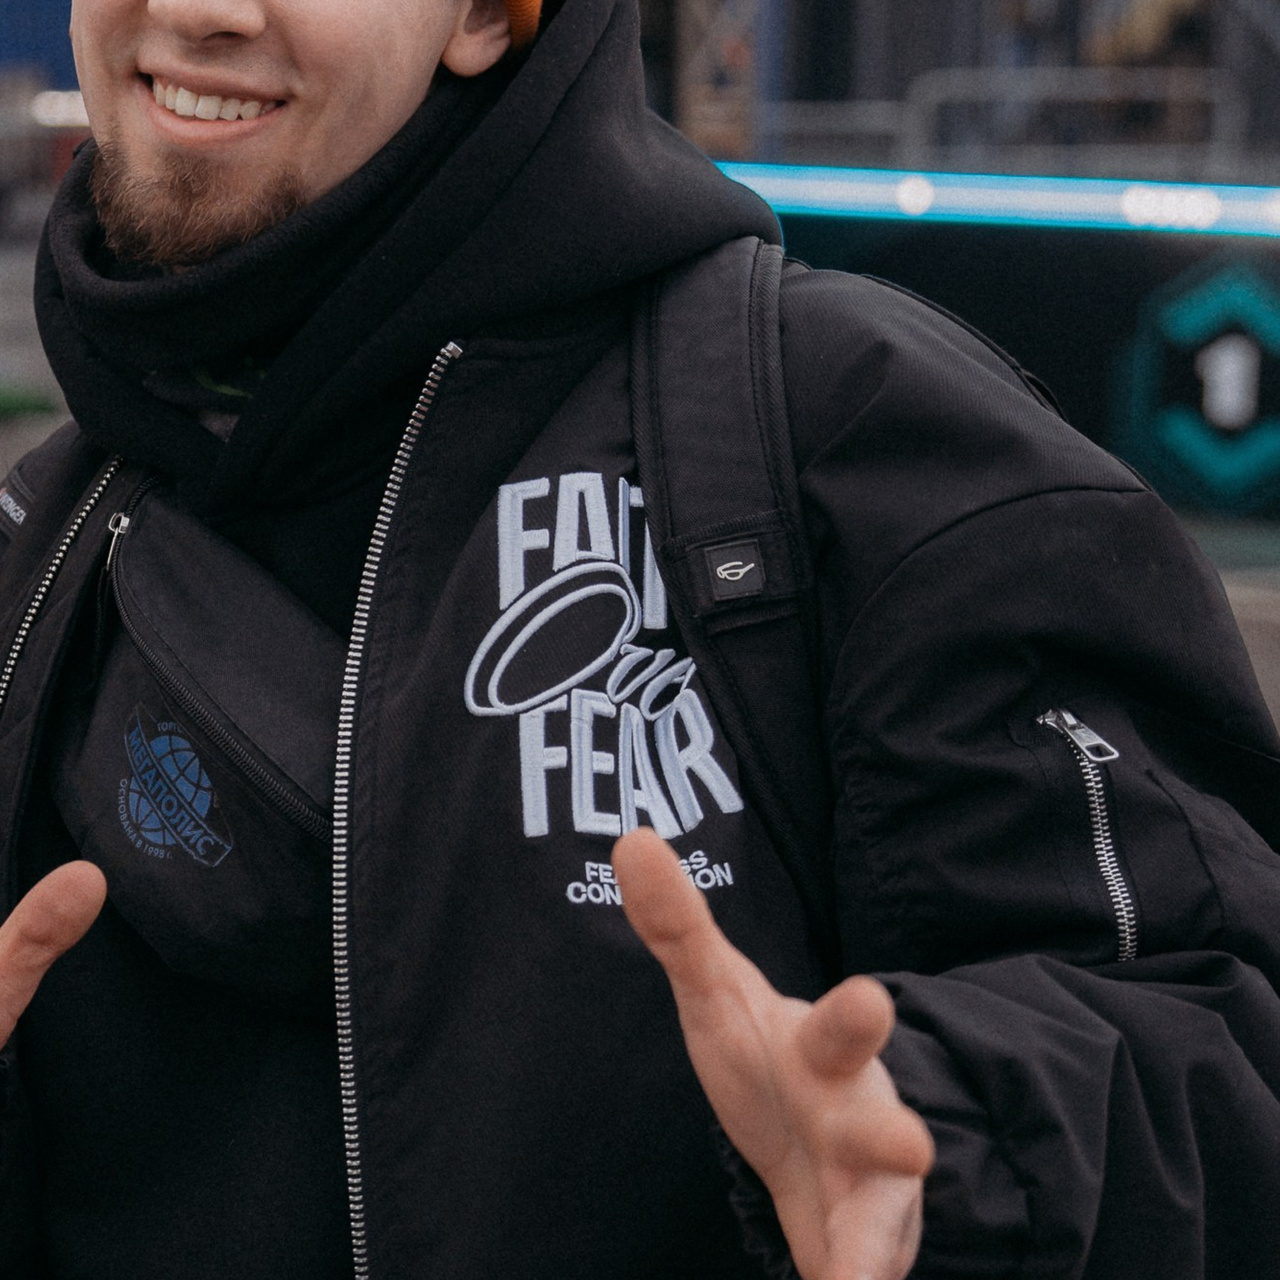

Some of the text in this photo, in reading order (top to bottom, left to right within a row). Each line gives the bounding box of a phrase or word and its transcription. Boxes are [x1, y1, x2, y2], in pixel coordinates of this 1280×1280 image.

[118, 778, 138, 842] ОСНОВАНА
[142, 845, 166, 860] 1998
[128, 726, 215, 856] МЕГАПОЛИС
[519, 687, 744, 839] FEAR
